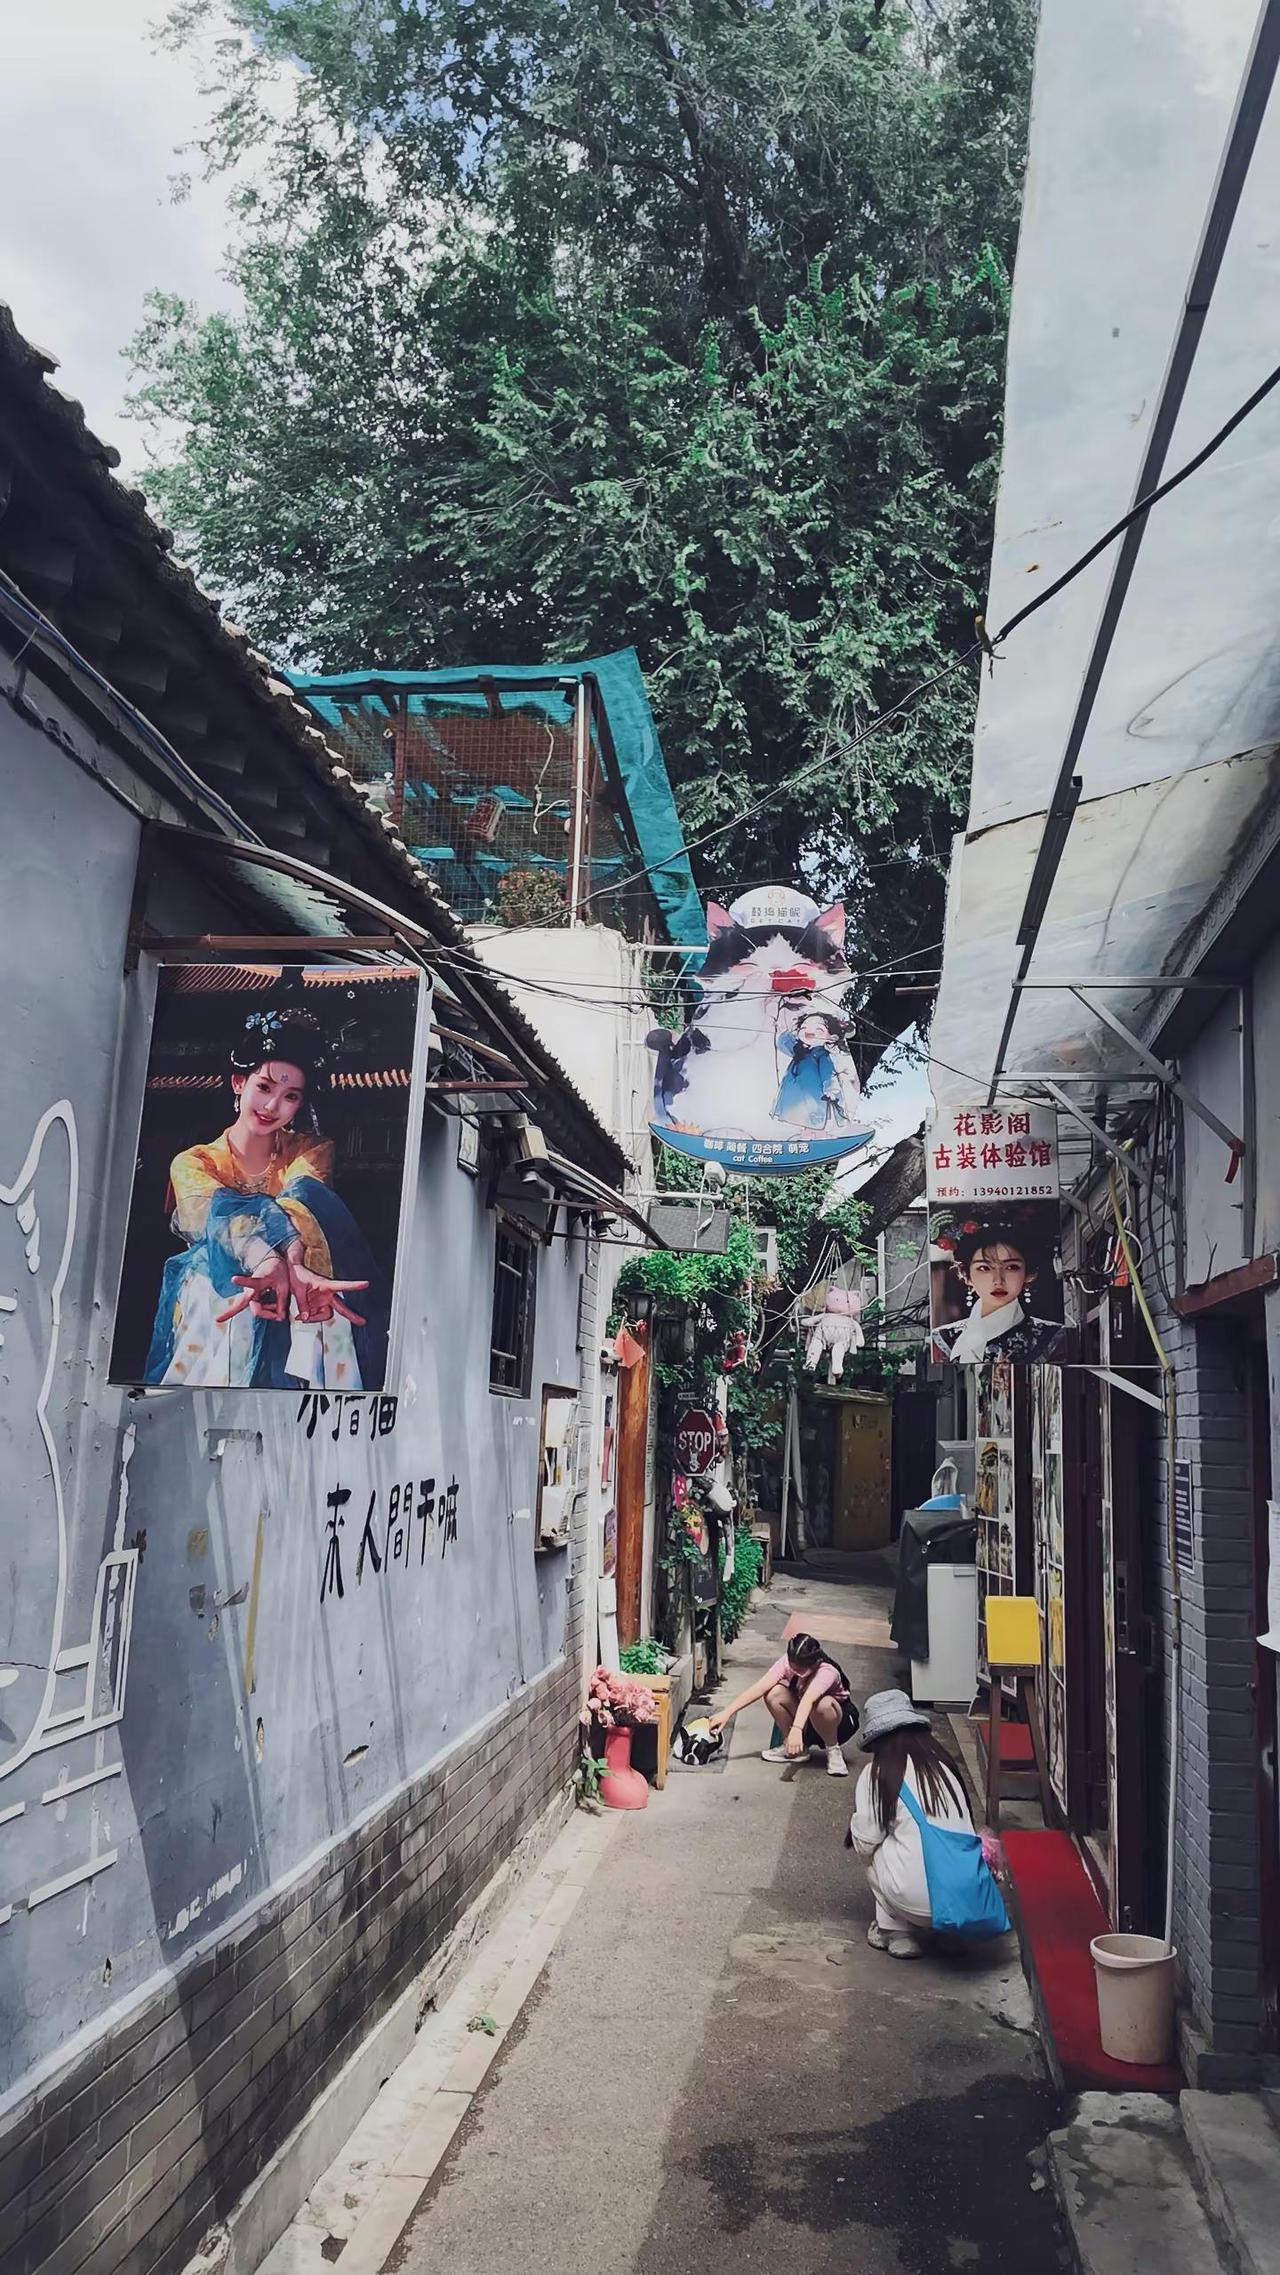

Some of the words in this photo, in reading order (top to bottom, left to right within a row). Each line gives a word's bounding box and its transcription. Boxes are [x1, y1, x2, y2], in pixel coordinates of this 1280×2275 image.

[953, 1112, 1031, 1136] 花影阁
[752, 1143, 783, 1154] 四合院
[788, 1143, 809, 1154] 萌宠
[932, 1140, 1052, 1170] 古装体验馆
[748, 1155, 773, 1163] Coffee
[973, 1186, 1053, 1196] 13940121852
[678, 1430, 712, 1452] STOP
